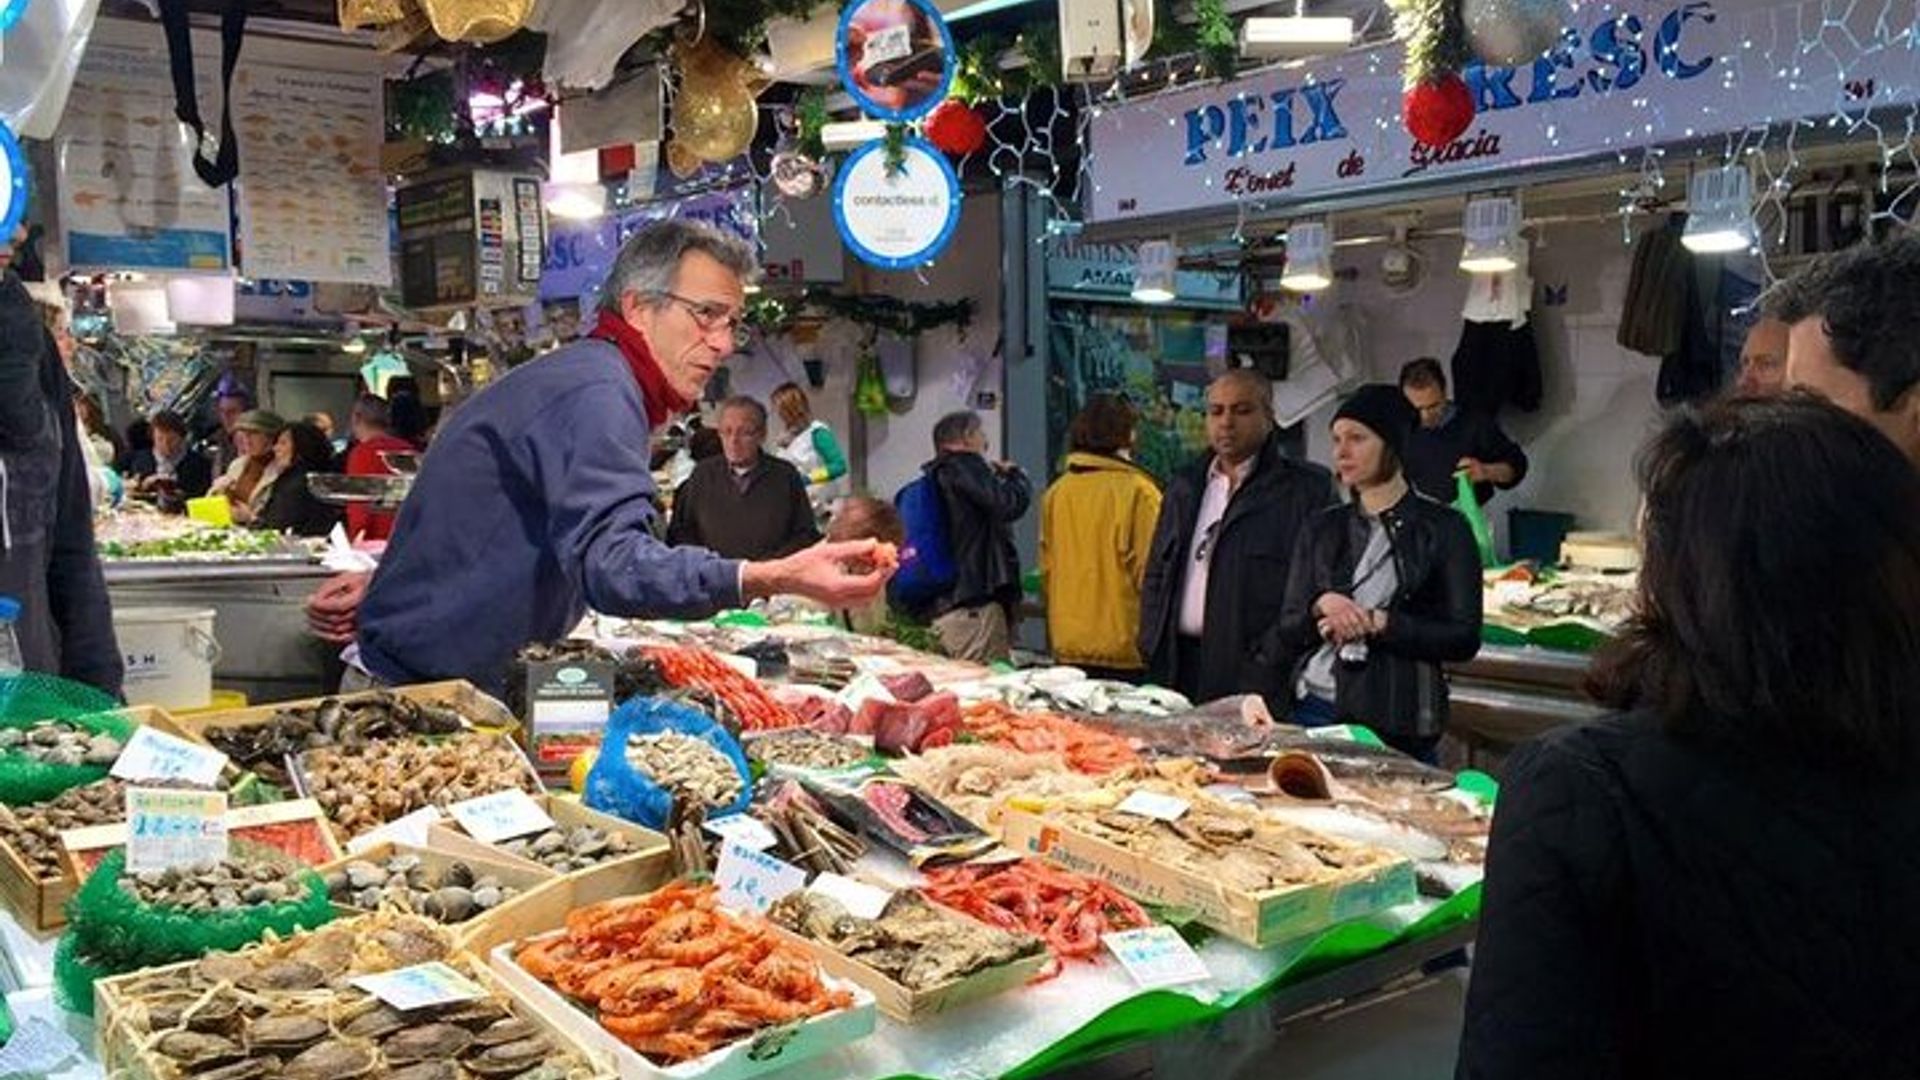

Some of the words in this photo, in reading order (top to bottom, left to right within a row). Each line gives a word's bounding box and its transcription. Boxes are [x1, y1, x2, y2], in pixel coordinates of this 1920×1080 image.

[1184, 78, 1348, 165] PEIX
[1465, 2, 1716, 113] RESC
[1336, 149, 1365, 179] de
